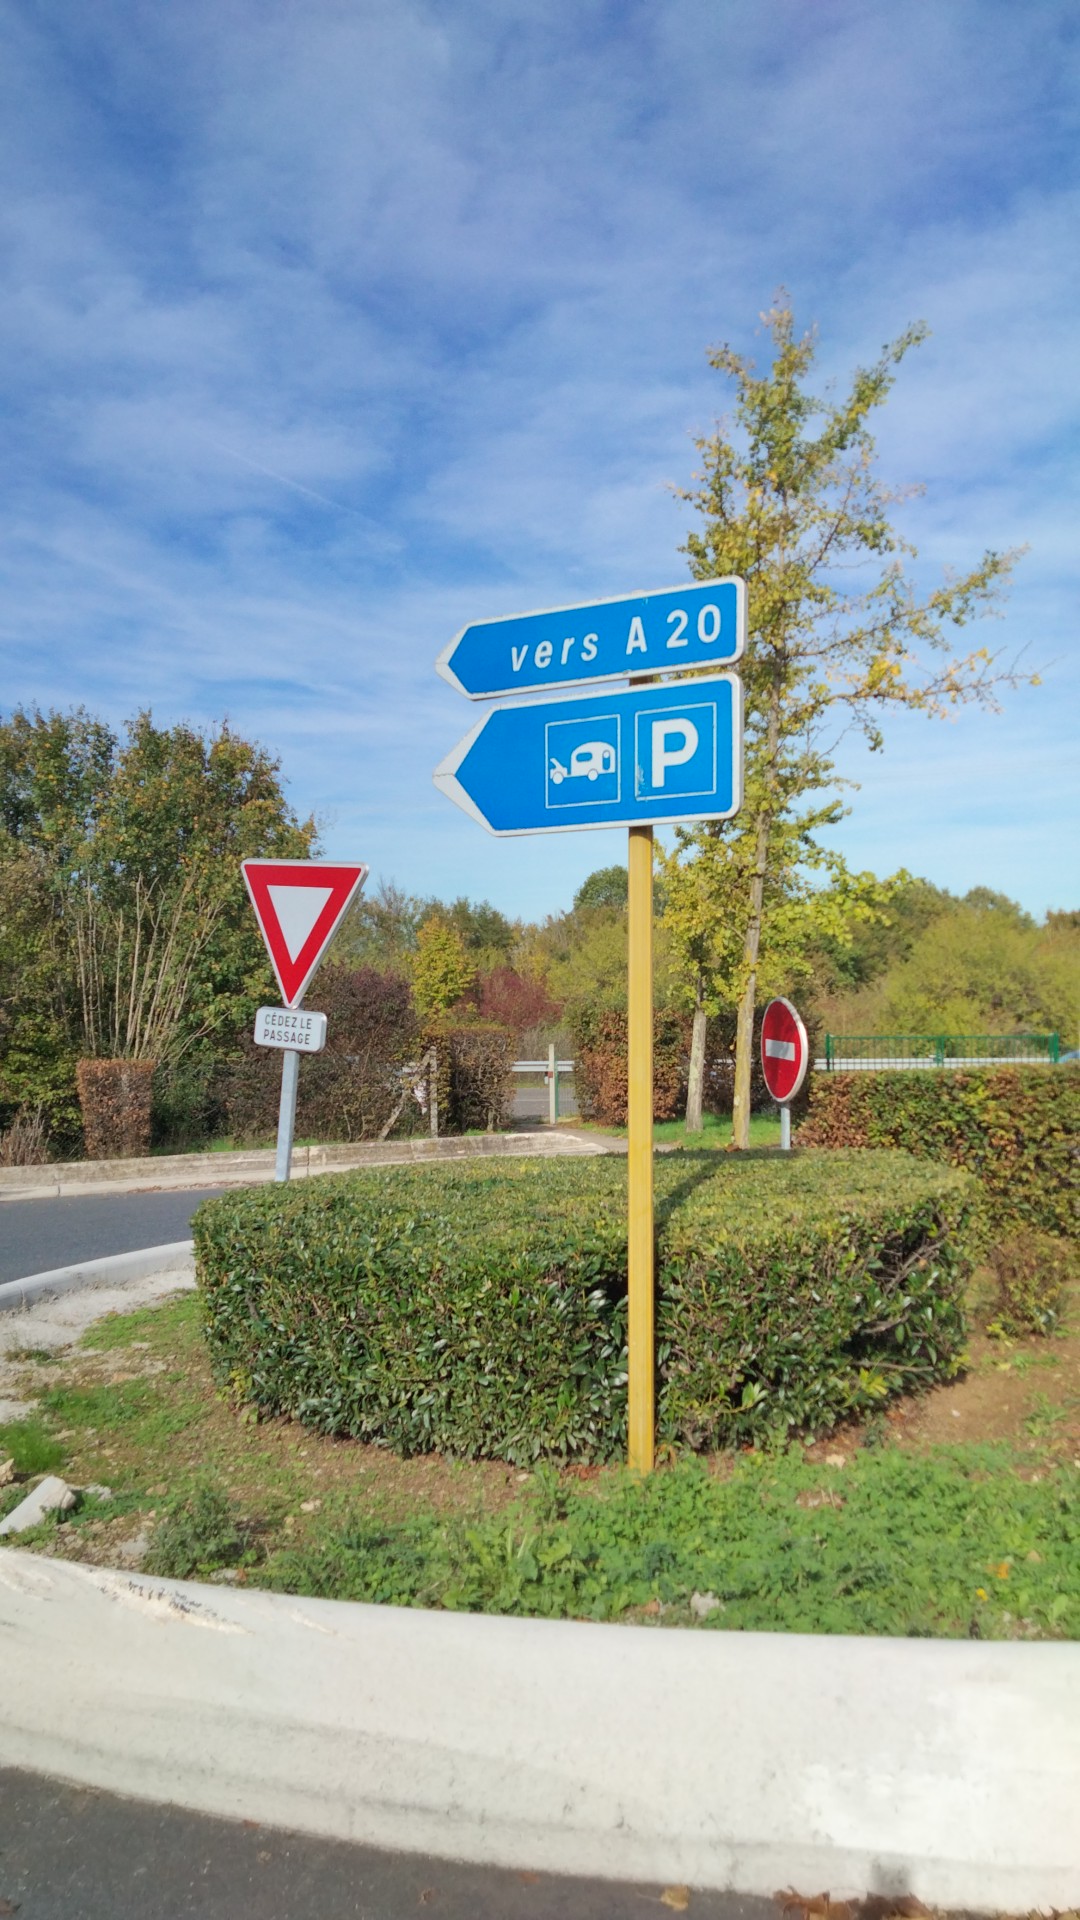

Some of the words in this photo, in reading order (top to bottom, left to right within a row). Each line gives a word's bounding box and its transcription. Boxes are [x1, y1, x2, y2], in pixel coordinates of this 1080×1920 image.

[511, 633, 599, 672] vers
[625, 616, 648, 655] A
[666, 604, 721, 649] 20
[652, 717, 699, 788] P
[264, 1029, 310, 1045] PASSAGE
[265, 1012, 297, 1028] CÉDEZ
[300, 1018, 312, 1029] LE
